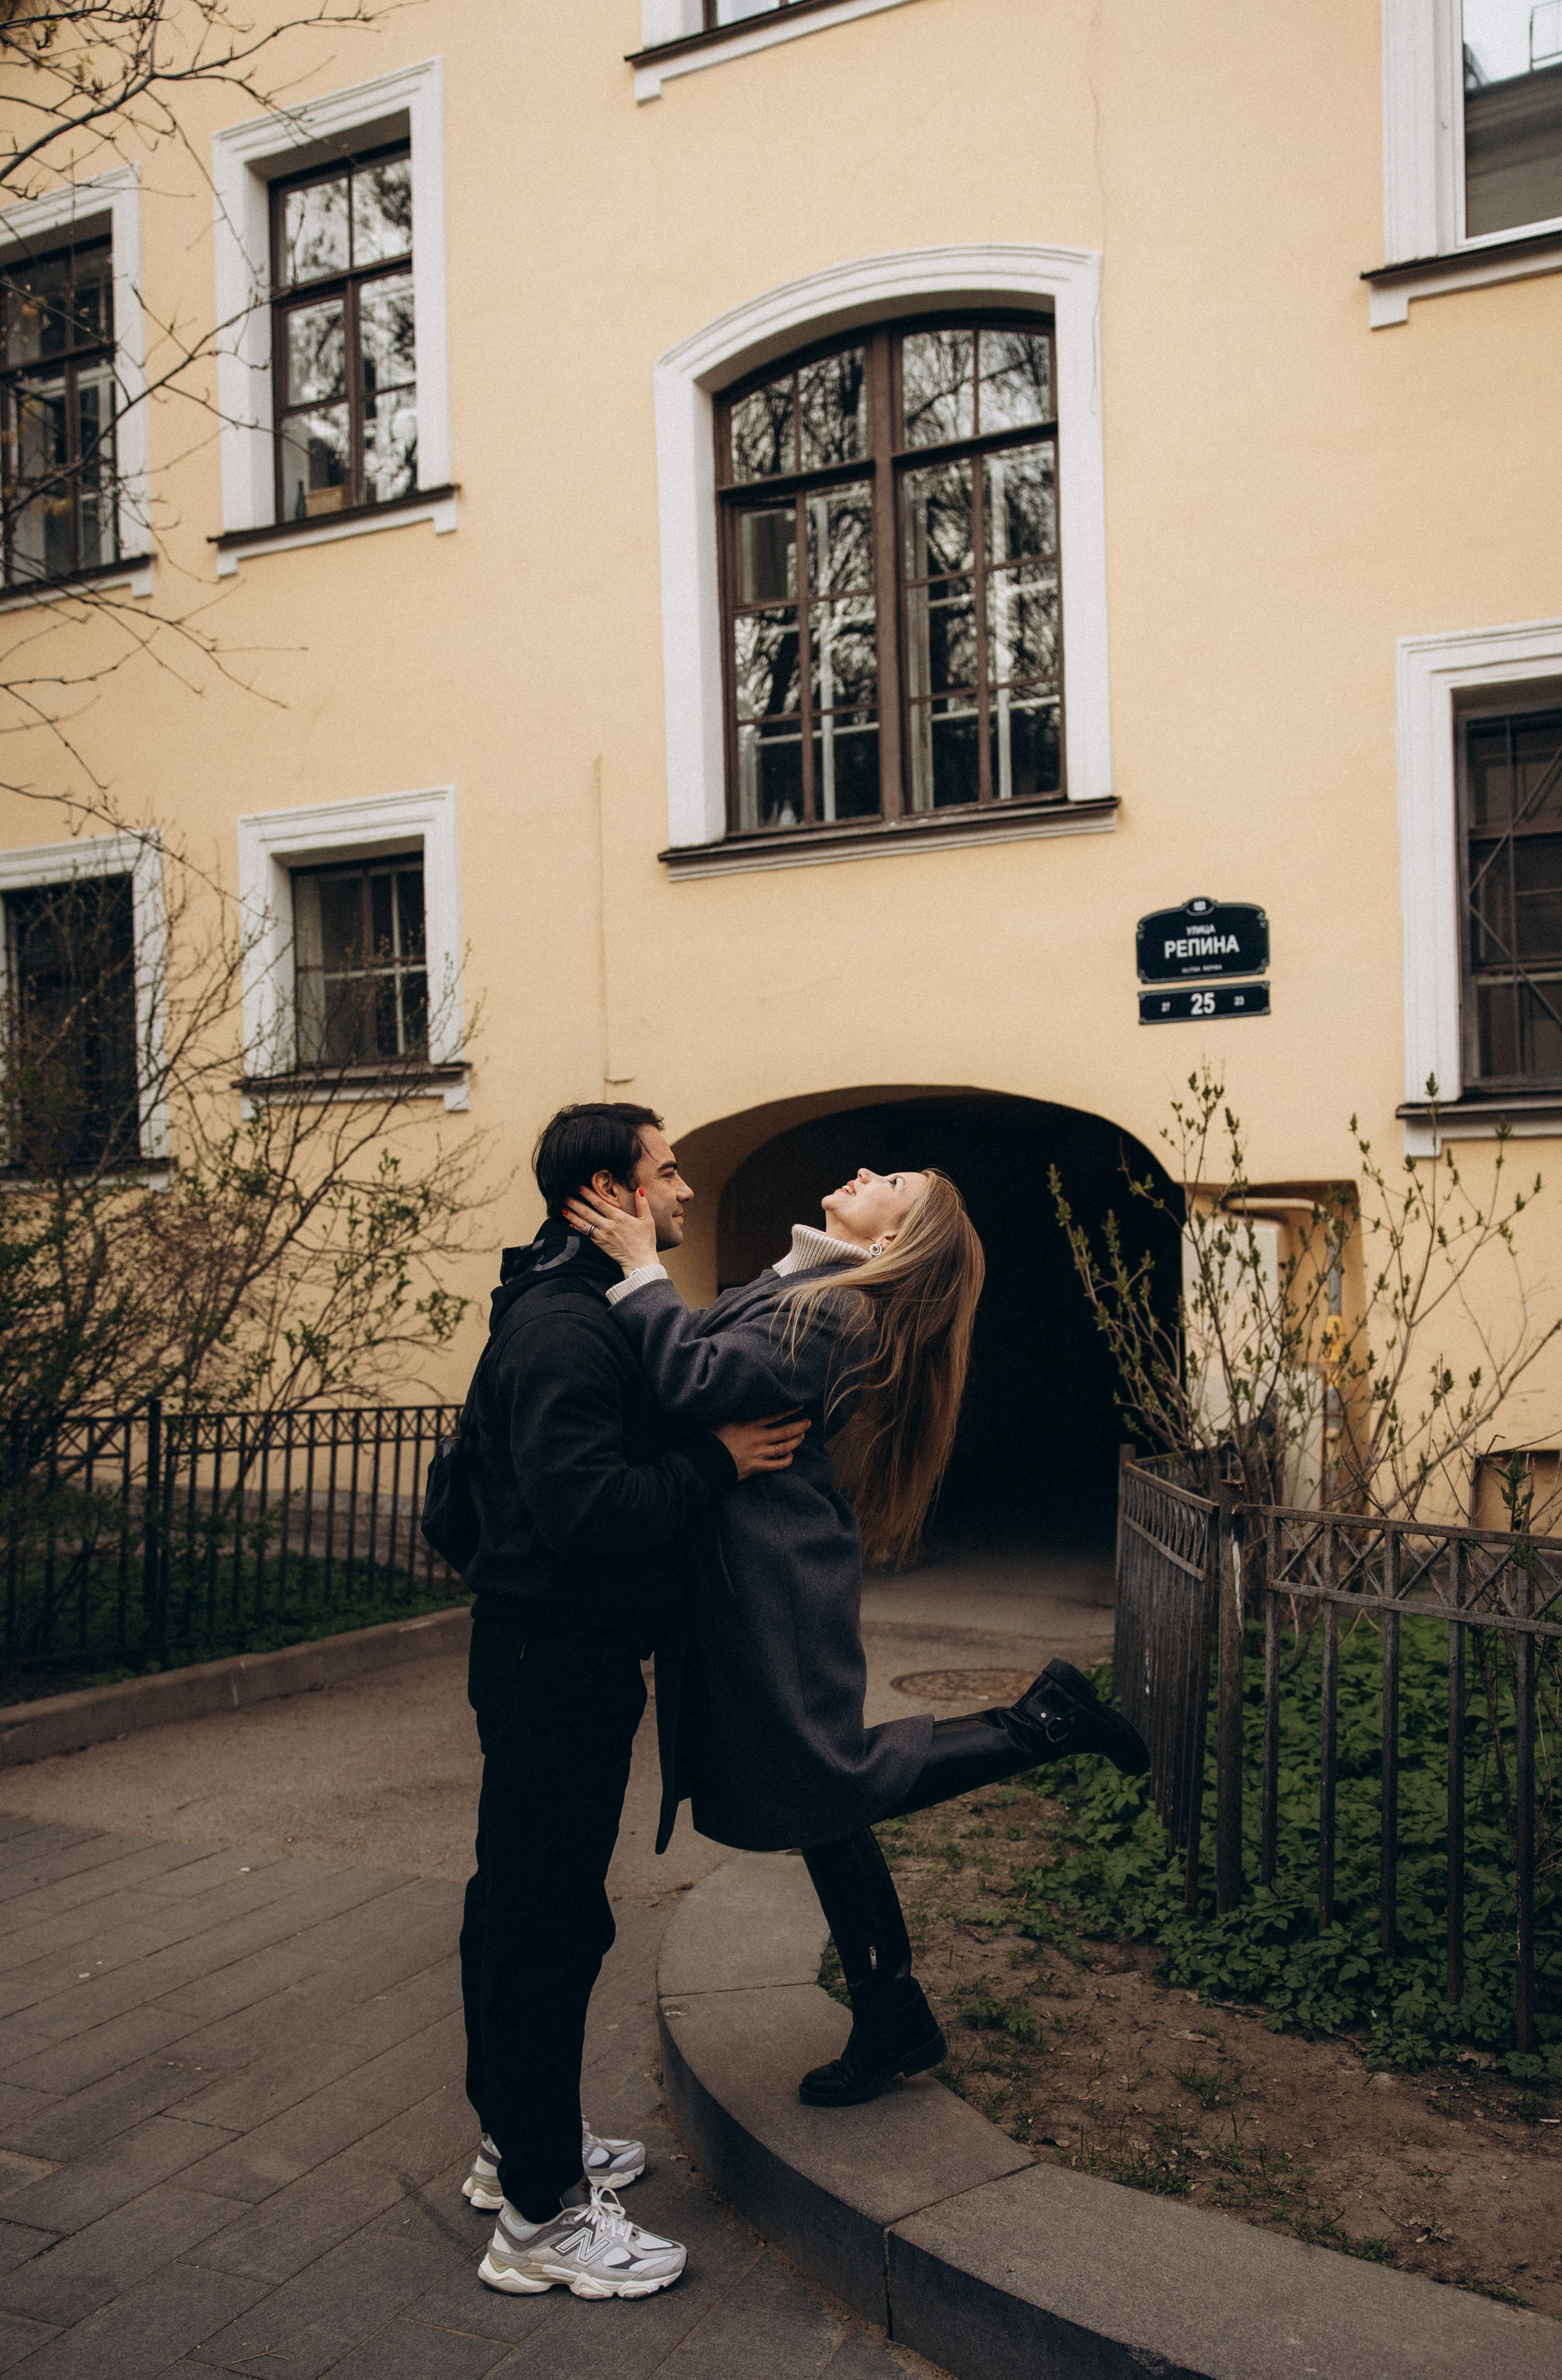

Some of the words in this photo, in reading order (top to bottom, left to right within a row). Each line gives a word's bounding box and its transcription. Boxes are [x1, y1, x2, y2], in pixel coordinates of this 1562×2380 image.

[1186, 924, 1216, 936] УЛИЦА
[1164, 935, 1240, 959] РЕПИНА
[1190, 991, 1215, 1015] 25
